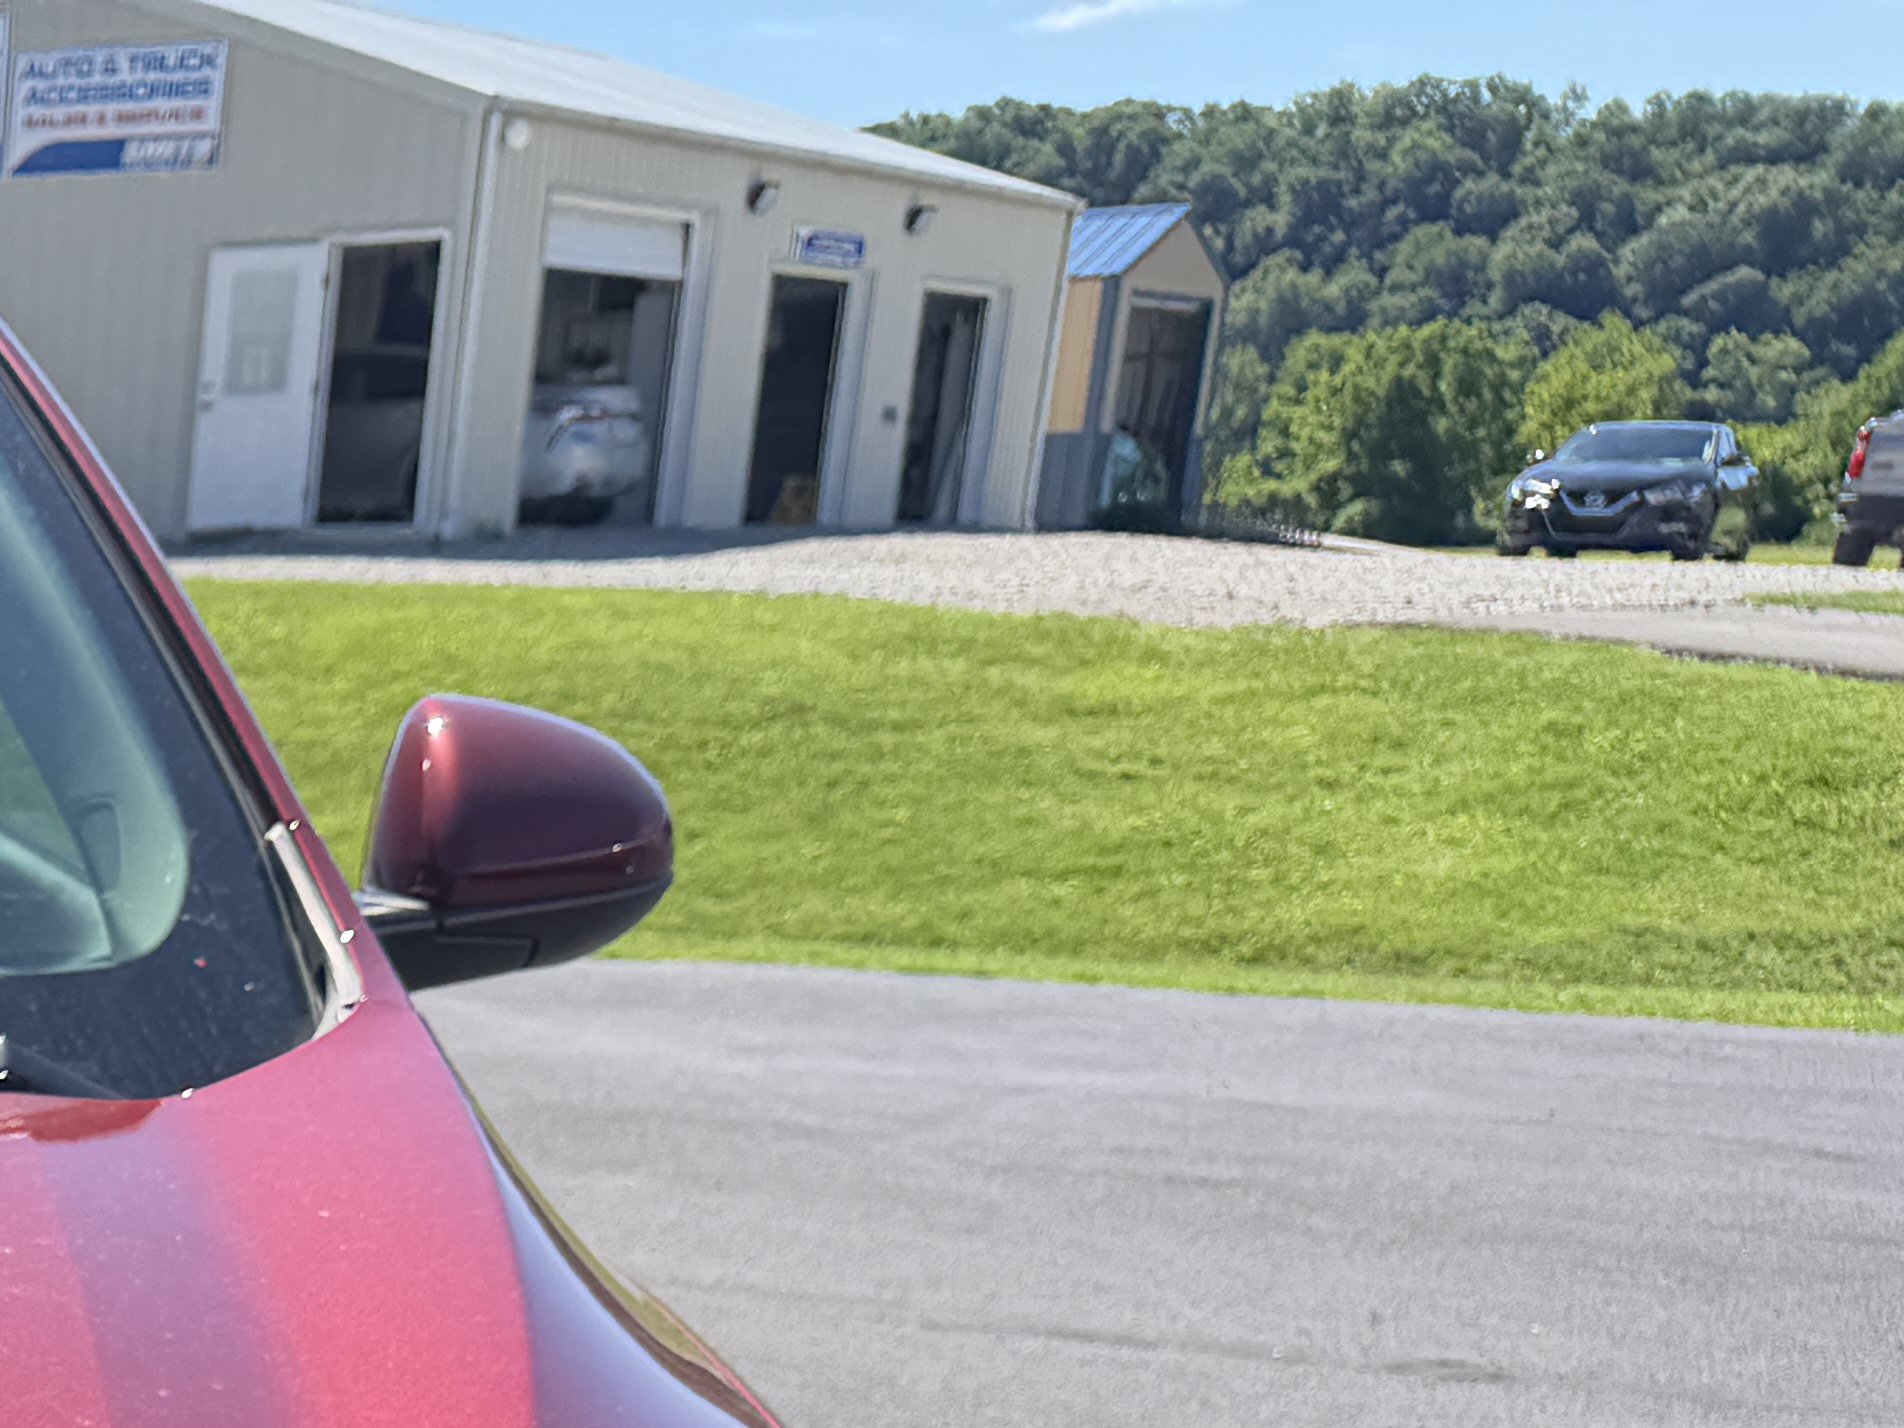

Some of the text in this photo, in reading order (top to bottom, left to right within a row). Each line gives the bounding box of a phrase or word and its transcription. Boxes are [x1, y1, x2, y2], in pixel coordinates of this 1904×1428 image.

[20, 54, 94, 80] AUTO
[128, 47, 219, 74] TRUCK
[23, 75, 213, 108] ACCESSORIES
